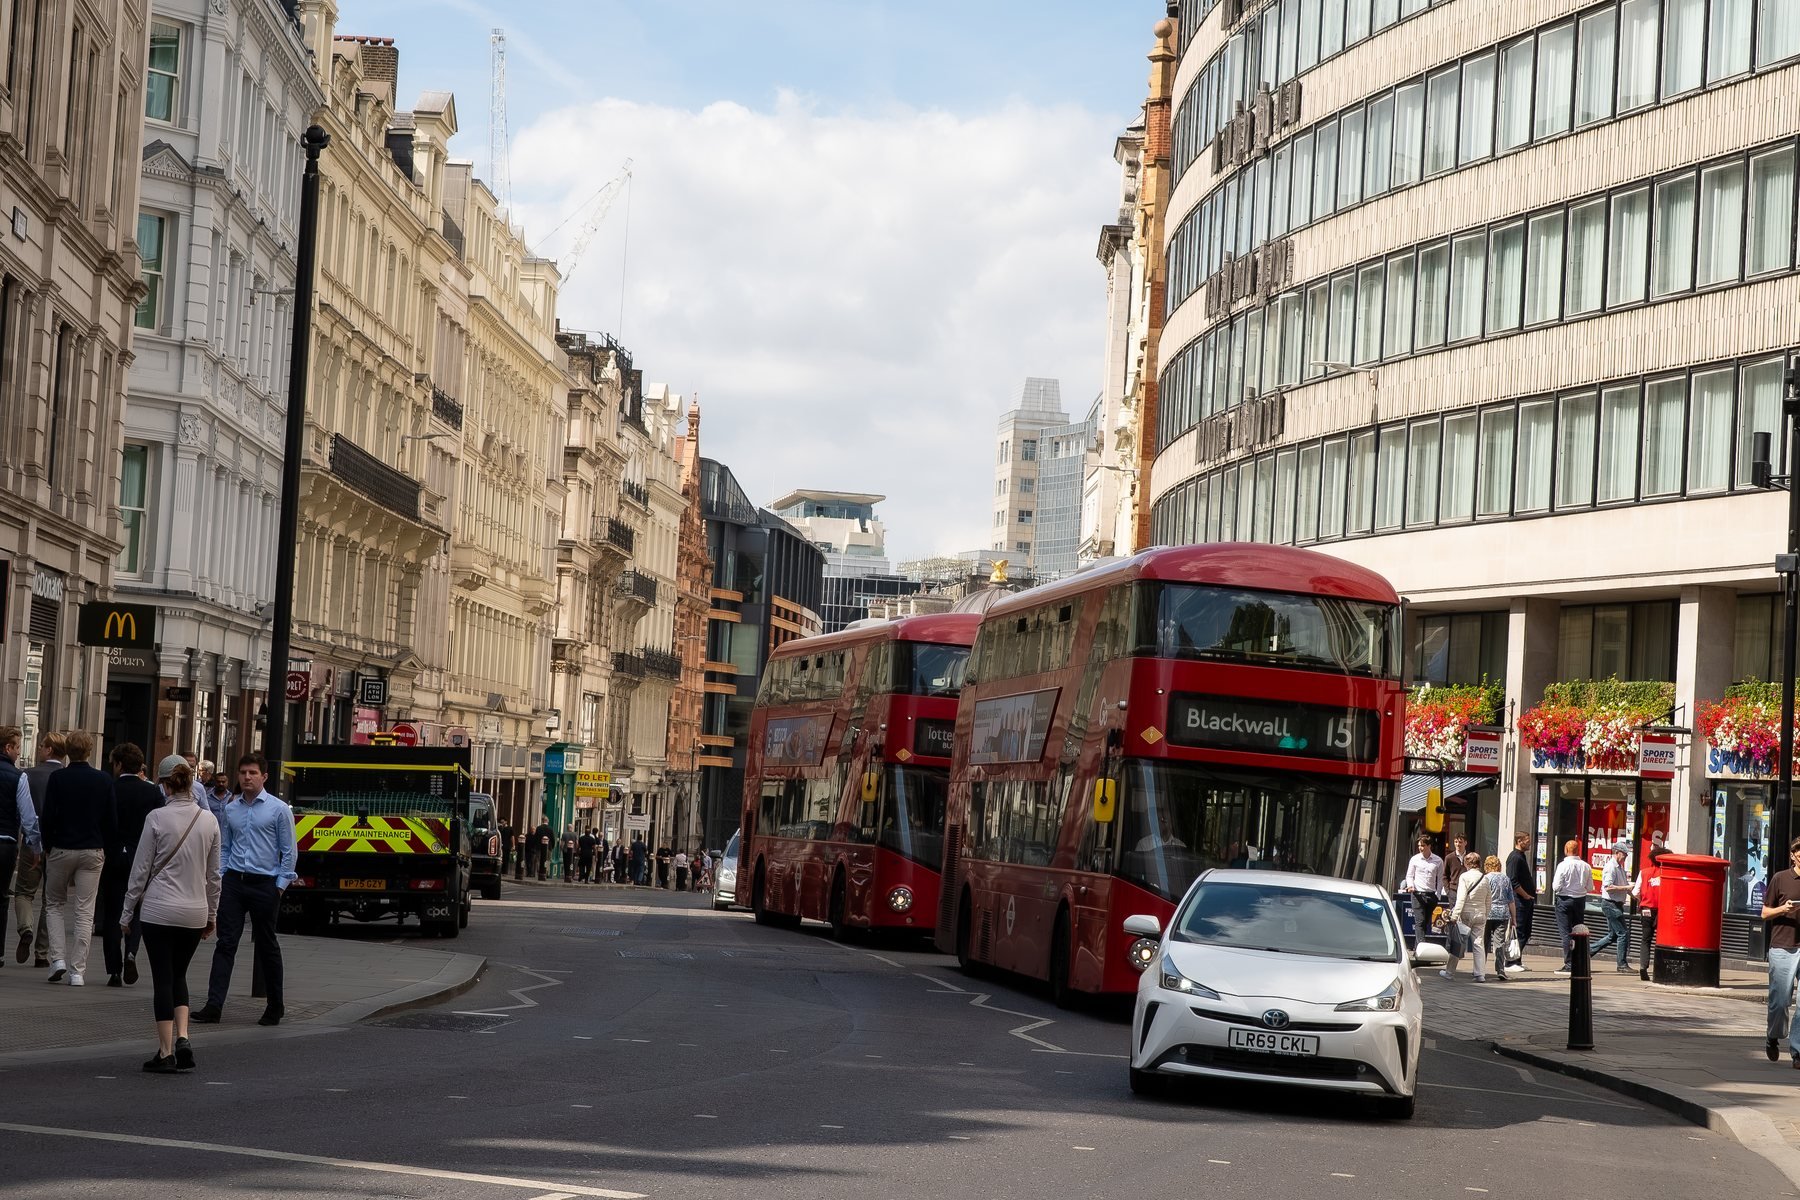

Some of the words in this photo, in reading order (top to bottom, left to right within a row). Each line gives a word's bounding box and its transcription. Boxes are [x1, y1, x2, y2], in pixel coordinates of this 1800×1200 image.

[108, 656, 145, 667] ROPERTY
[1187, 707, 1290, 737] Blackwall
[1326, 717, 1353, 748] 15
[928, 725, 953, 741] Totte
[1469, 745, 1498, 755] SPORTS
[1643, 749, 1675, 758] SPORTS
[578, 773, 590, 781] TO
[592, 774, 609, 782] LET
[314, 829, 351, 838] HIGHWAY
[353, 829, 411, 839] MAINTENANCE
[344, 880, 365, 888] WP75
[366, 880, 383, 888] GZY
[1235, 1031, 1276, 1049] LR69
[1280, 1036, 1310, 1053] CKL
